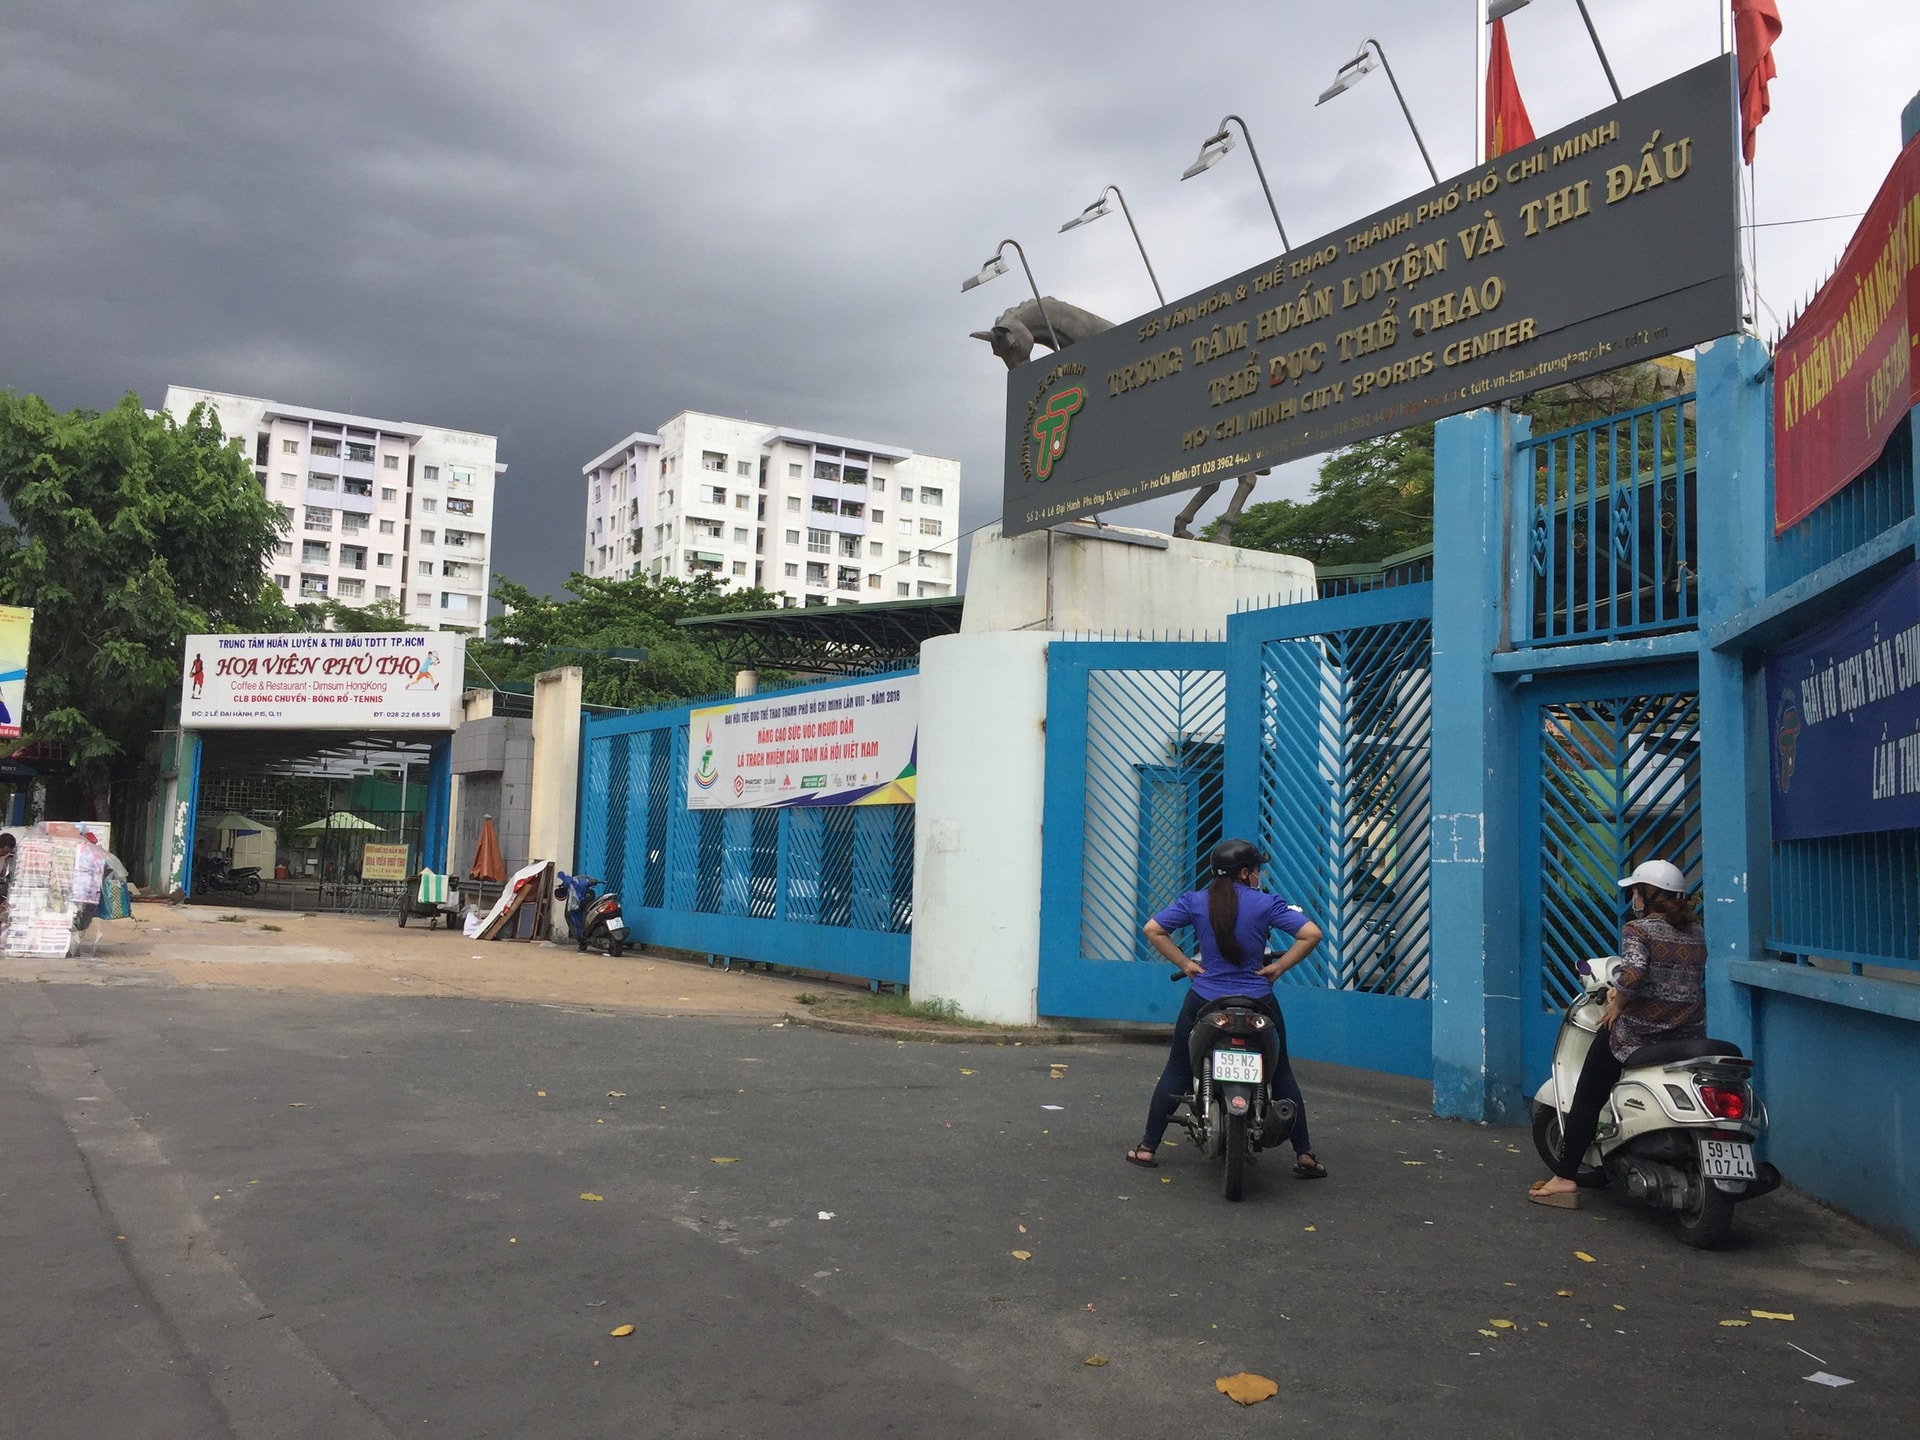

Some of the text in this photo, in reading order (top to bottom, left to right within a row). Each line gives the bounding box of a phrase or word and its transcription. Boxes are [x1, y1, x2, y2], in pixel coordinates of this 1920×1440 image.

[1137, 120, 1621, 342] SỞ VĂN HÓA & THỂ THAO THÀNH PHỐ HỒ CHÍ MINH
[1107, 128, 1692, 397] TRUNG TÂM HUẤN LUYỆN VÀ THI ĐẤU
[1208, 275, 1504, 407] THỂ DỤC THỂ THAO
[1785, 352, 1800, 431] KỶ
[1802, 336, 1832, 420] NIỆM
[1832, 312, 1852, 383] 128
[1850, 272, 1878, 360] NĂM
[1213, 415, 1244, 440] CHI
[1248, 399, 1297, 431] MINH
[1301, 380, 1345, 412] CITY
[1352, 351, 1436, 397] SPORTS
[1442, 317, 1537, 366] CENTER
[1202, 461, 1216, 474] 028
[1217, 455, 1233, 469] 3962
[219, 635, 425, 650] TRUNG TÂM HUẤN LUYỆN & THI ĐẤU TDTT TP.HCM
[216, 652, 420, 678] HOA VIÊN PHÚ THỌ
[1801, 658, 1822, 726] GIẢI
[1822, 657, 1837, 718] VÔ
[1839, 653, 1866, 723] ĐỊCH
[1866, 621, 1895, 702] BẮN
[230, 681, 257, 691] Coffee
[259, 681, 265, 690] &
[266, 681, 307, 691] Restaurant
[313, 681, 344, 690] Dimsum
[346, 681, 387, 692] HongKong
[251, 692, 273, 702] BÓNG
[312, 692, 335, 702] BÓNG
[354, 694, 383, 702] TENNIS
[770, 707, 781, 719] THAO
[828, 698, 842, 711] MINH
[758, 716, 854, 744] NÂNG CAO SỨC VÓC NGƯỜI DÂN
[746, 750, 764, 766] TRÁCH
[766, 748, 785, 768] NHIỆM
[787, 745, 799, 764] CỦA
[801, 745, 818, 762] TOÀN
[820, 743, 828, 761] XÃ
[830, 742, 841, 763] HỘI
[843, 740, 858, 761] VIỆT
[860, 741, 878, 757] NAM
[1873, 721, 1896, 799] LẦN
[1221, 1053, 1254, 1067] 59-N2
[1216, 1066, 1259, 1081] 985.87
[1708, 1142, 1744, 1160] 59-L1
[1706, 1158, 1753, 1177] 107.44
